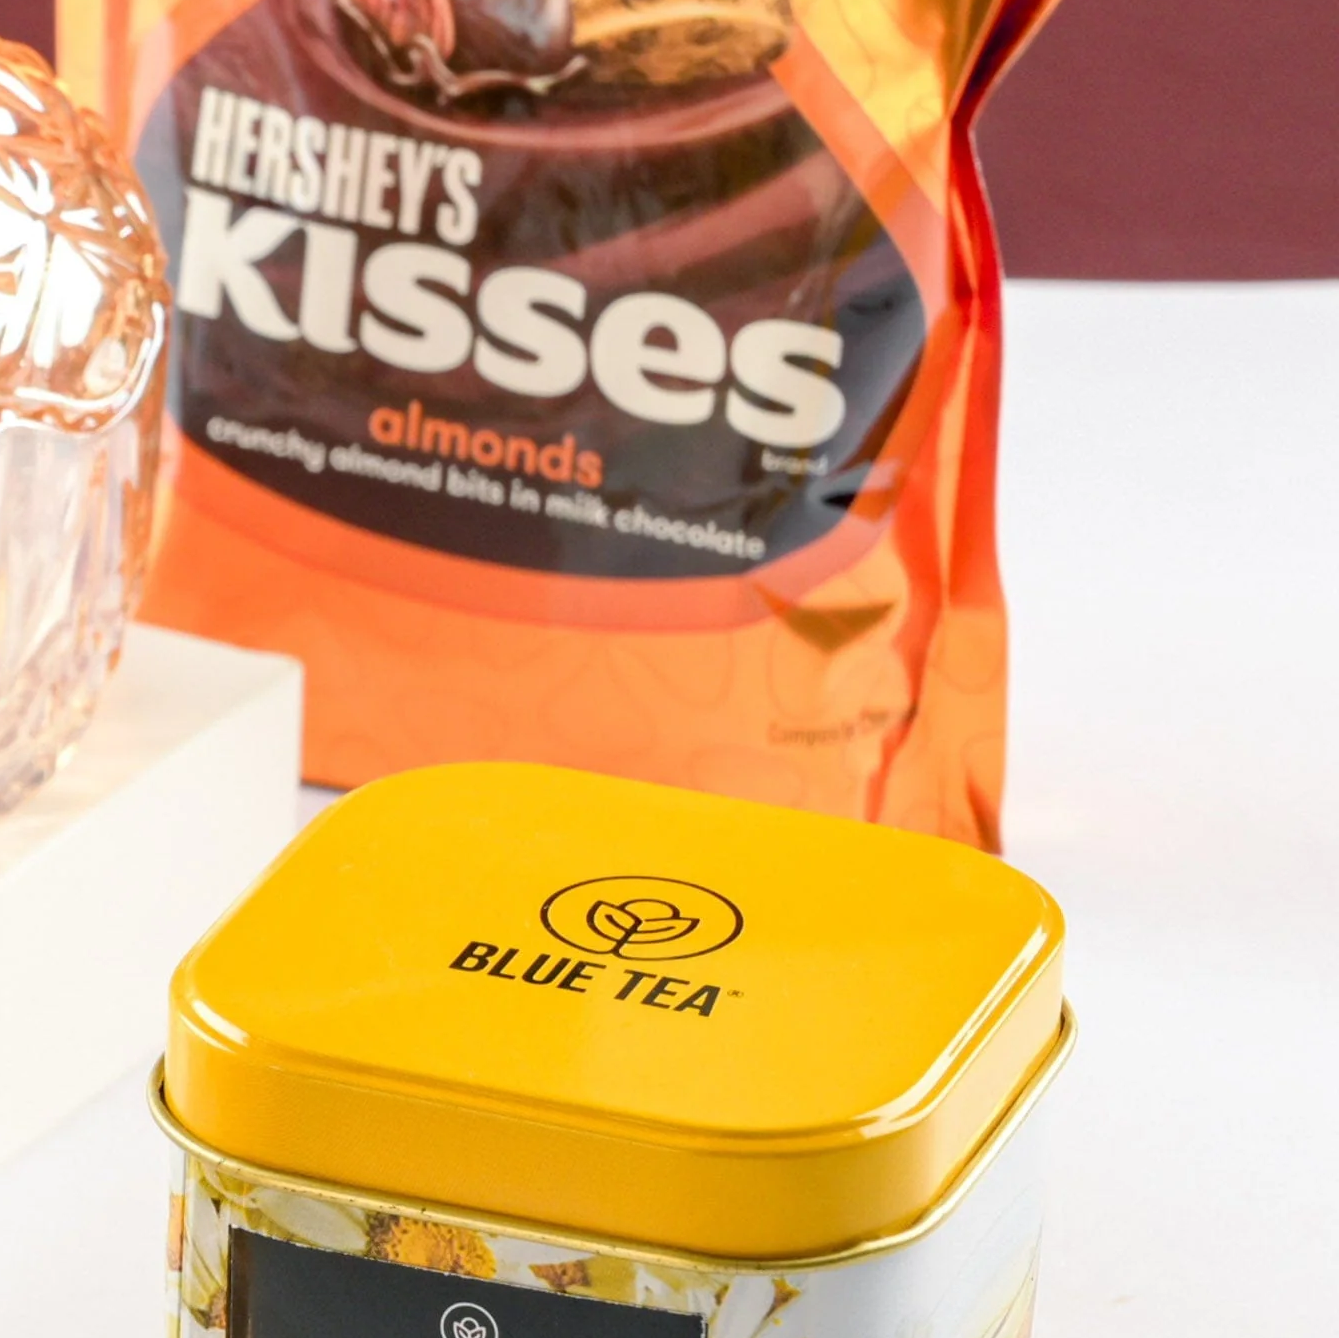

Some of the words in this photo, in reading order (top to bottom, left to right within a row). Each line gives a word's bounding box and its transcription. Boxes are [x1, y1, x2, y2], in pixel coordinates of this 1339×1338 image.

[191, 87, 483, 246] HERSHEY'S
[206, 416, 325, 473] crunchy
[329, 442, 443, 492] almond
[446, 463, 505, 506] bits
[509, 477, 541, 513] in
[545, 490, 609, 529] milk
[613, 505, 766, 560] chocolate
[369, 400, 604, 488] almonds
[760, 447, 829, 477] brand
[448, 940, 607, 994] BLUE
